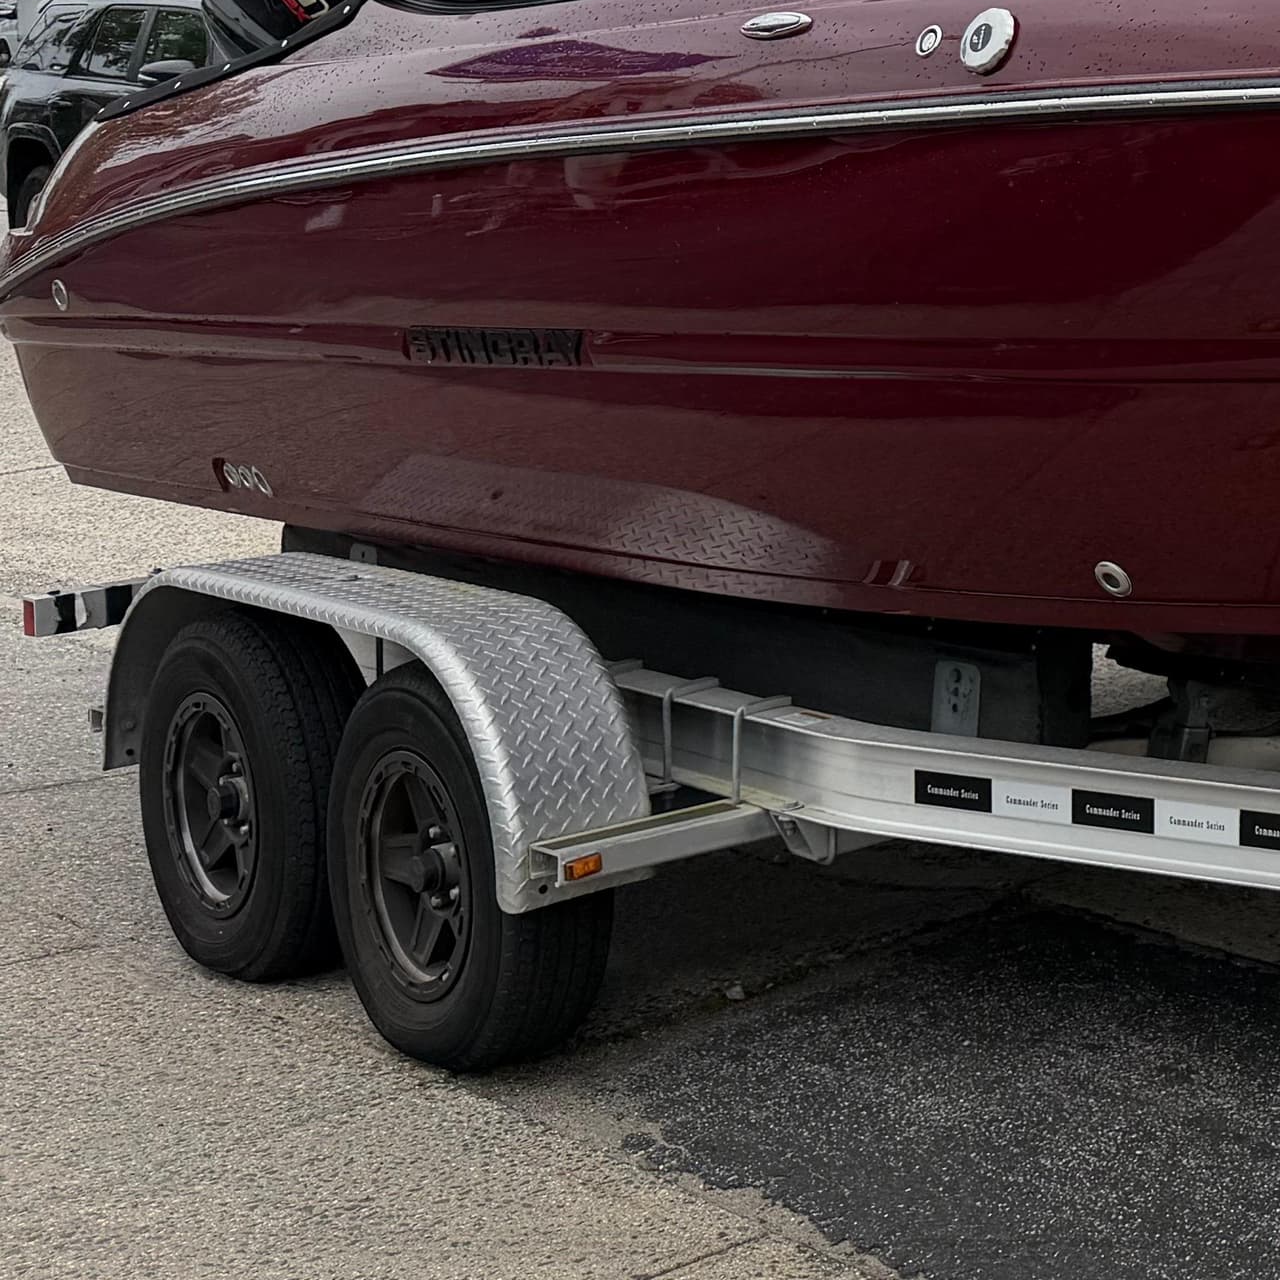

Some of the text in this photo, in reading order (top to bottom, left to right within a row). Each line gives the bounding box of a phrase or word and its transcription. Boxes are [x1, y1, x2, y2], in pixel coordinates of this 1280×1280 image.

[407, 327, 583, 367] STINGRAY
[927, 784, 979, 800] Commander Series
[1005, 795, 1059, 811] Commander Series
[1085, 804, 1141, 821] Commander Series
[1169, 815, 1225, 832] Commander Series
